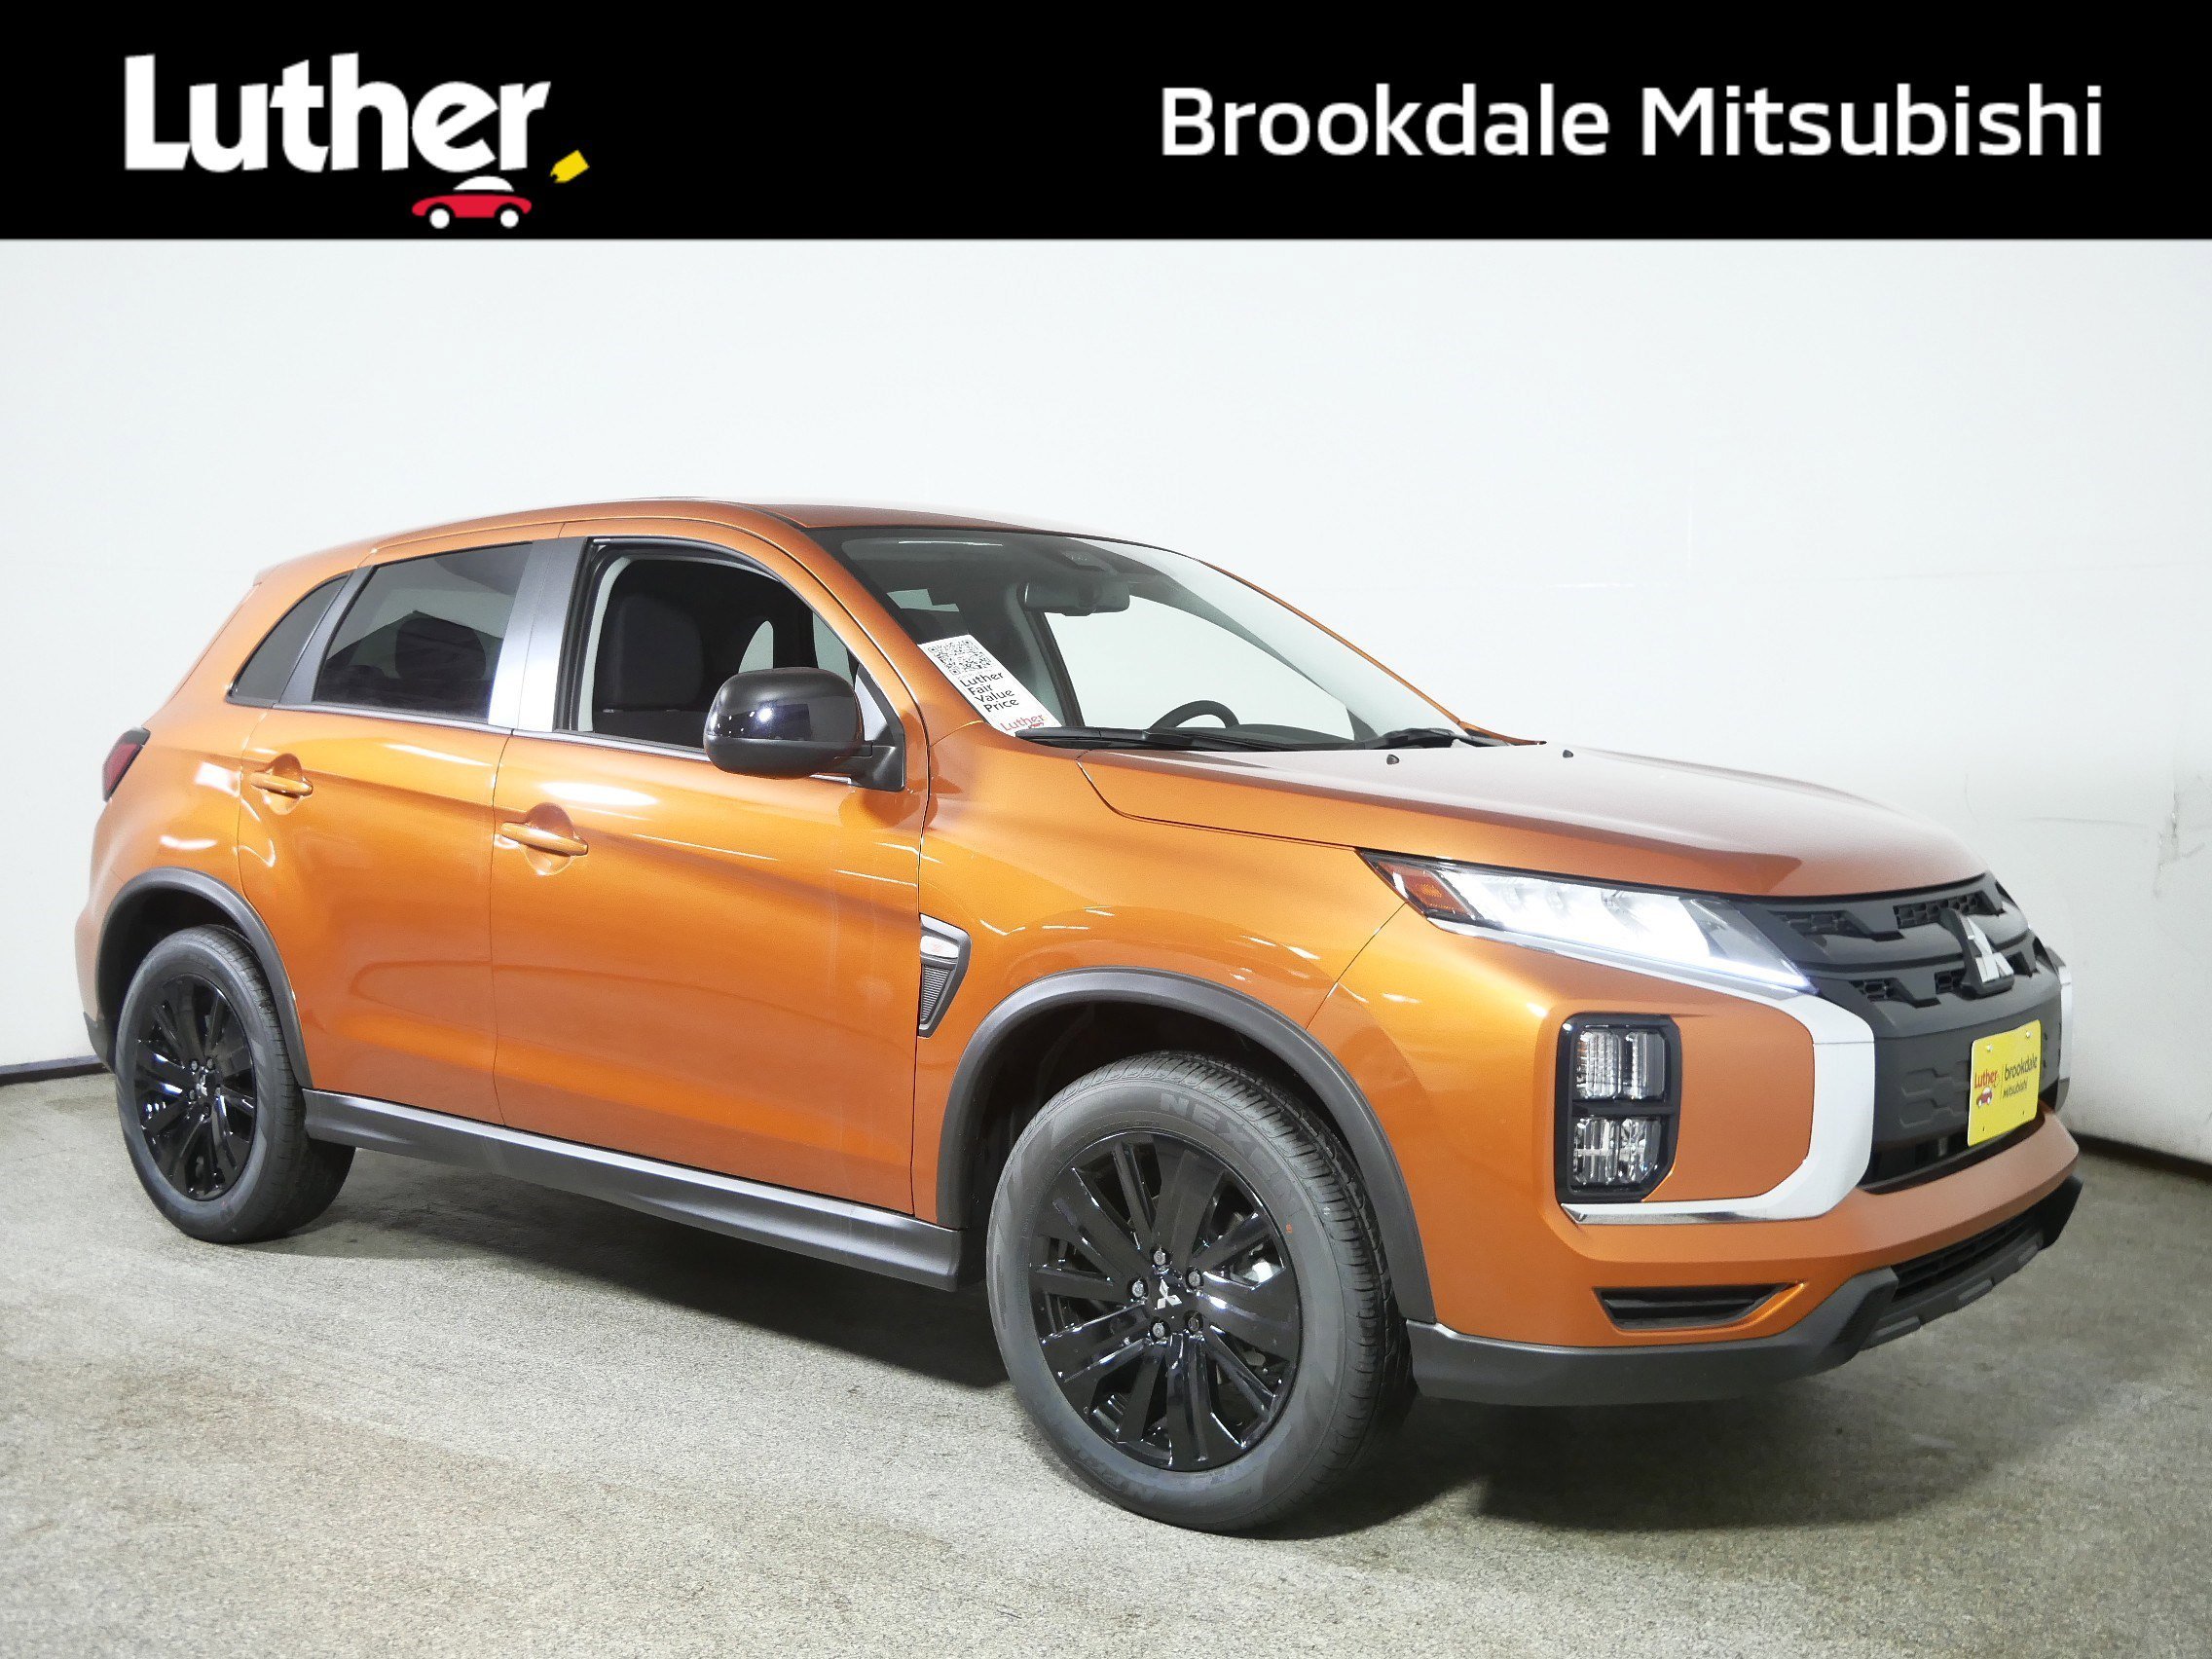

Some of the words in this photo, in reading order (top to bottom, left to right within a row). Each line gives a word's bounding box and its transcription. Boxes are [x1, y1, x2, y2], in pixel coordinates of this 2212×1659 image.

[959, 671, 1004, 687] Luther
[968, 683, 993, 695] Fair
[974, 689, 1015, 703] Value
[983, 698, 1019, 713] Price
[1000, 714, 1045, 731] Luther
[2005, 1053, 2038, 1081] brookdale
[1974, 1069, 1998, 1088] Luther
